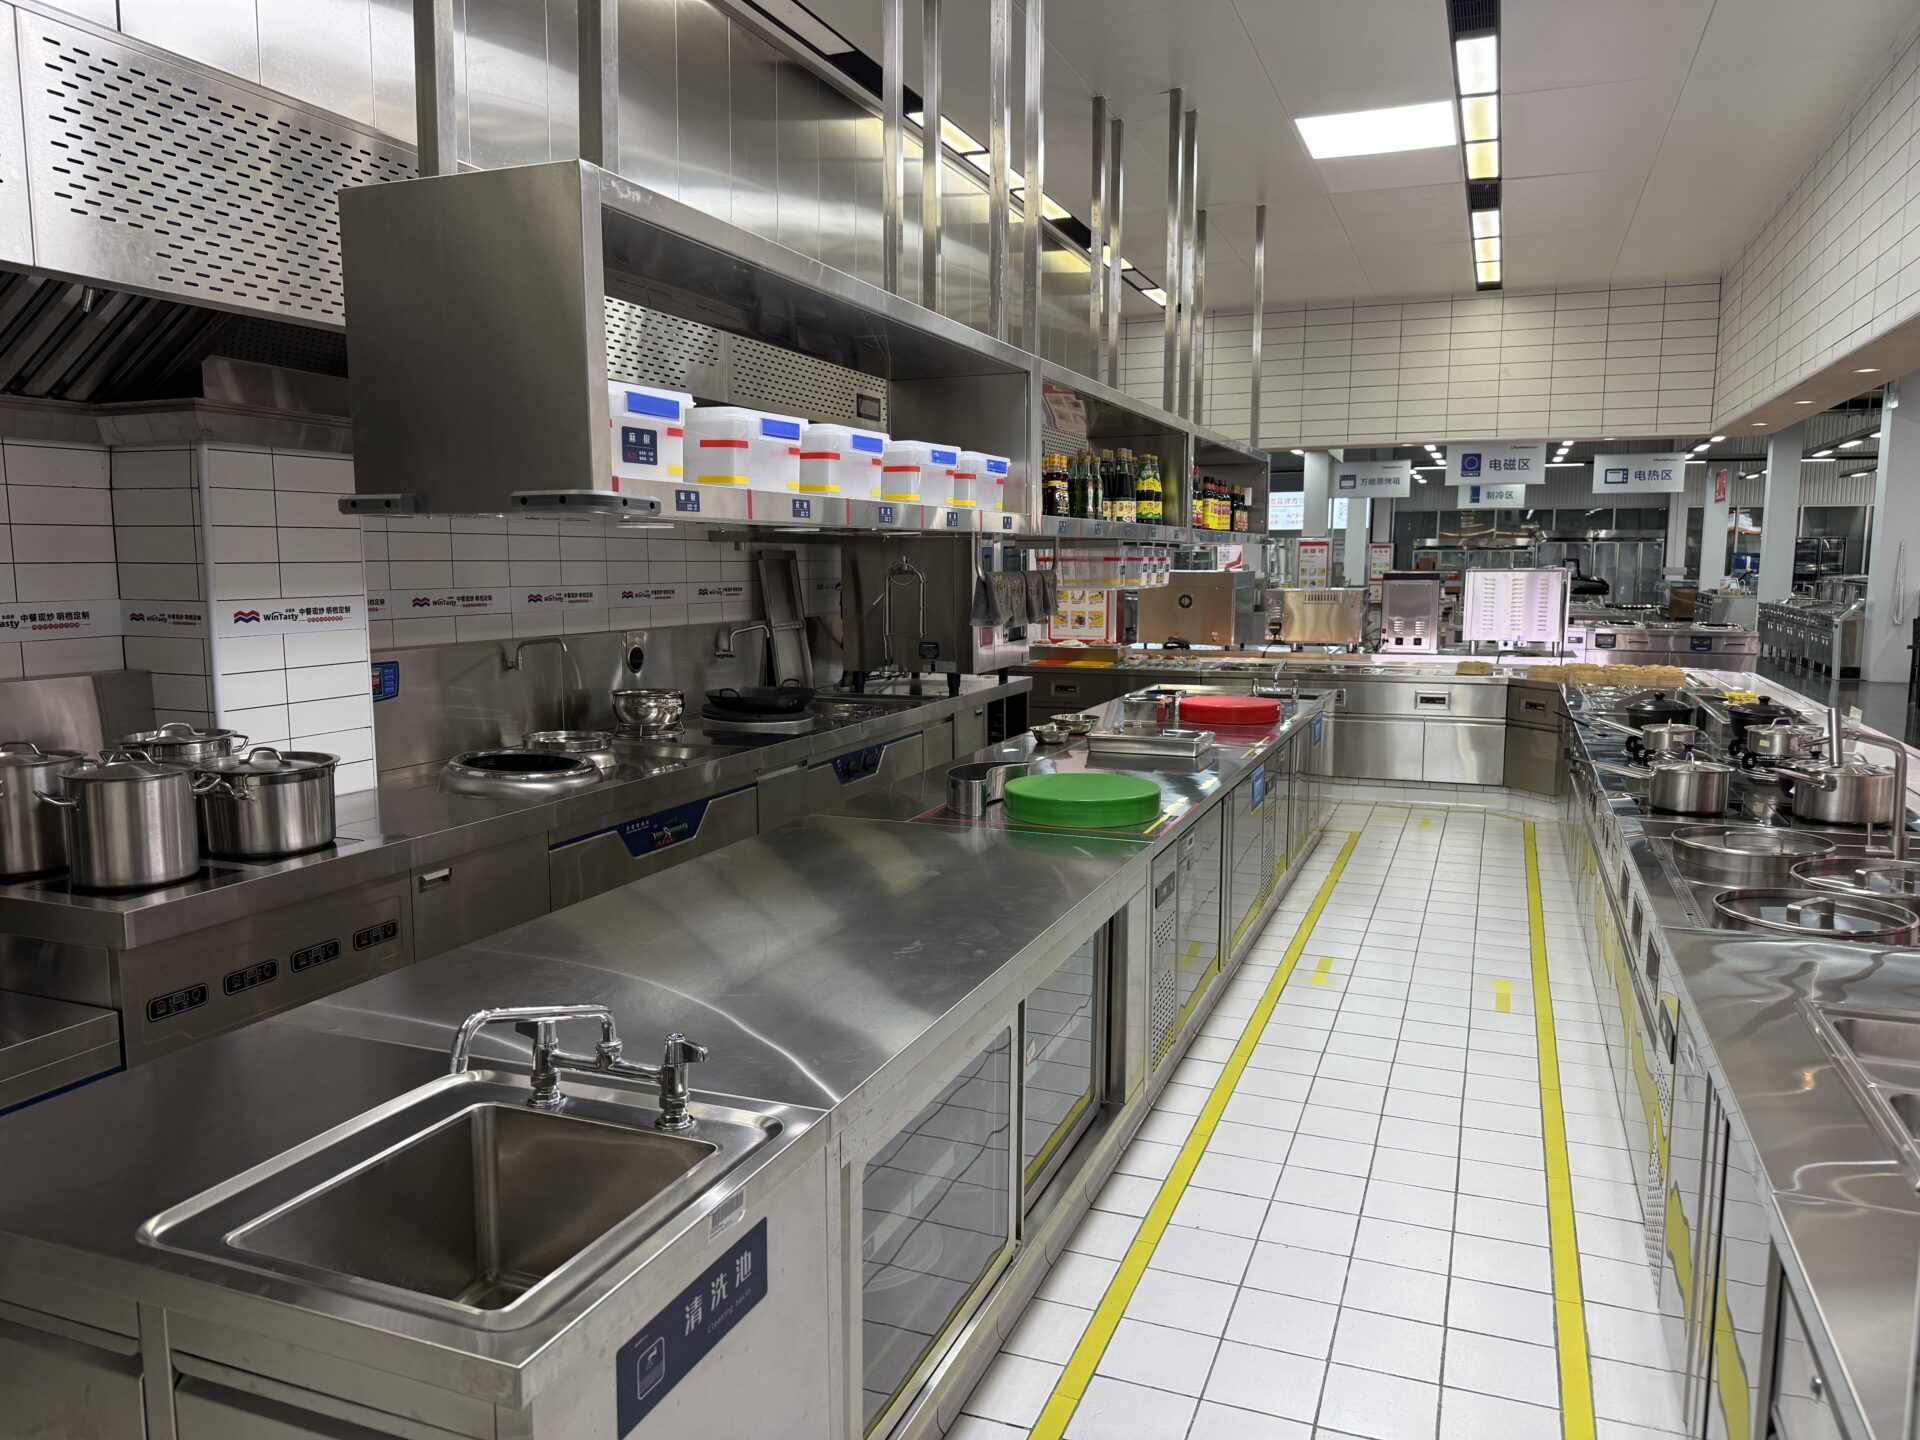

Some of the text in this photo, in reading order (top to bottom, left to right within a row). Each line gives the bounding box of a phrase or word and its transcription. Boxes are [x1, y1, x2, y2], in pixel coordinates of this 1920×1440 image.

[628, 432, 650, 445] 麻椒
[1488, 457, 1532, 471] 电磁区
[1634, 469, 1673, 481] 电热区
[1360, 477, 1401, 487] 万能蒸烤箱
[1485, 490, 1514, 500] 制冷区
[299, 606, 325, 616] 中餐现炒
[326, 605, 351, 614] 明档定制
[20, 612, 55, 622] 中餐现炒
[56, 611, 90, 621] 明档定制
[263, 612, 299, 622] WinTasty
[685, 1250, 752, 1337] 清洗池
[707, 1304, 734, 1334] Cleaning
